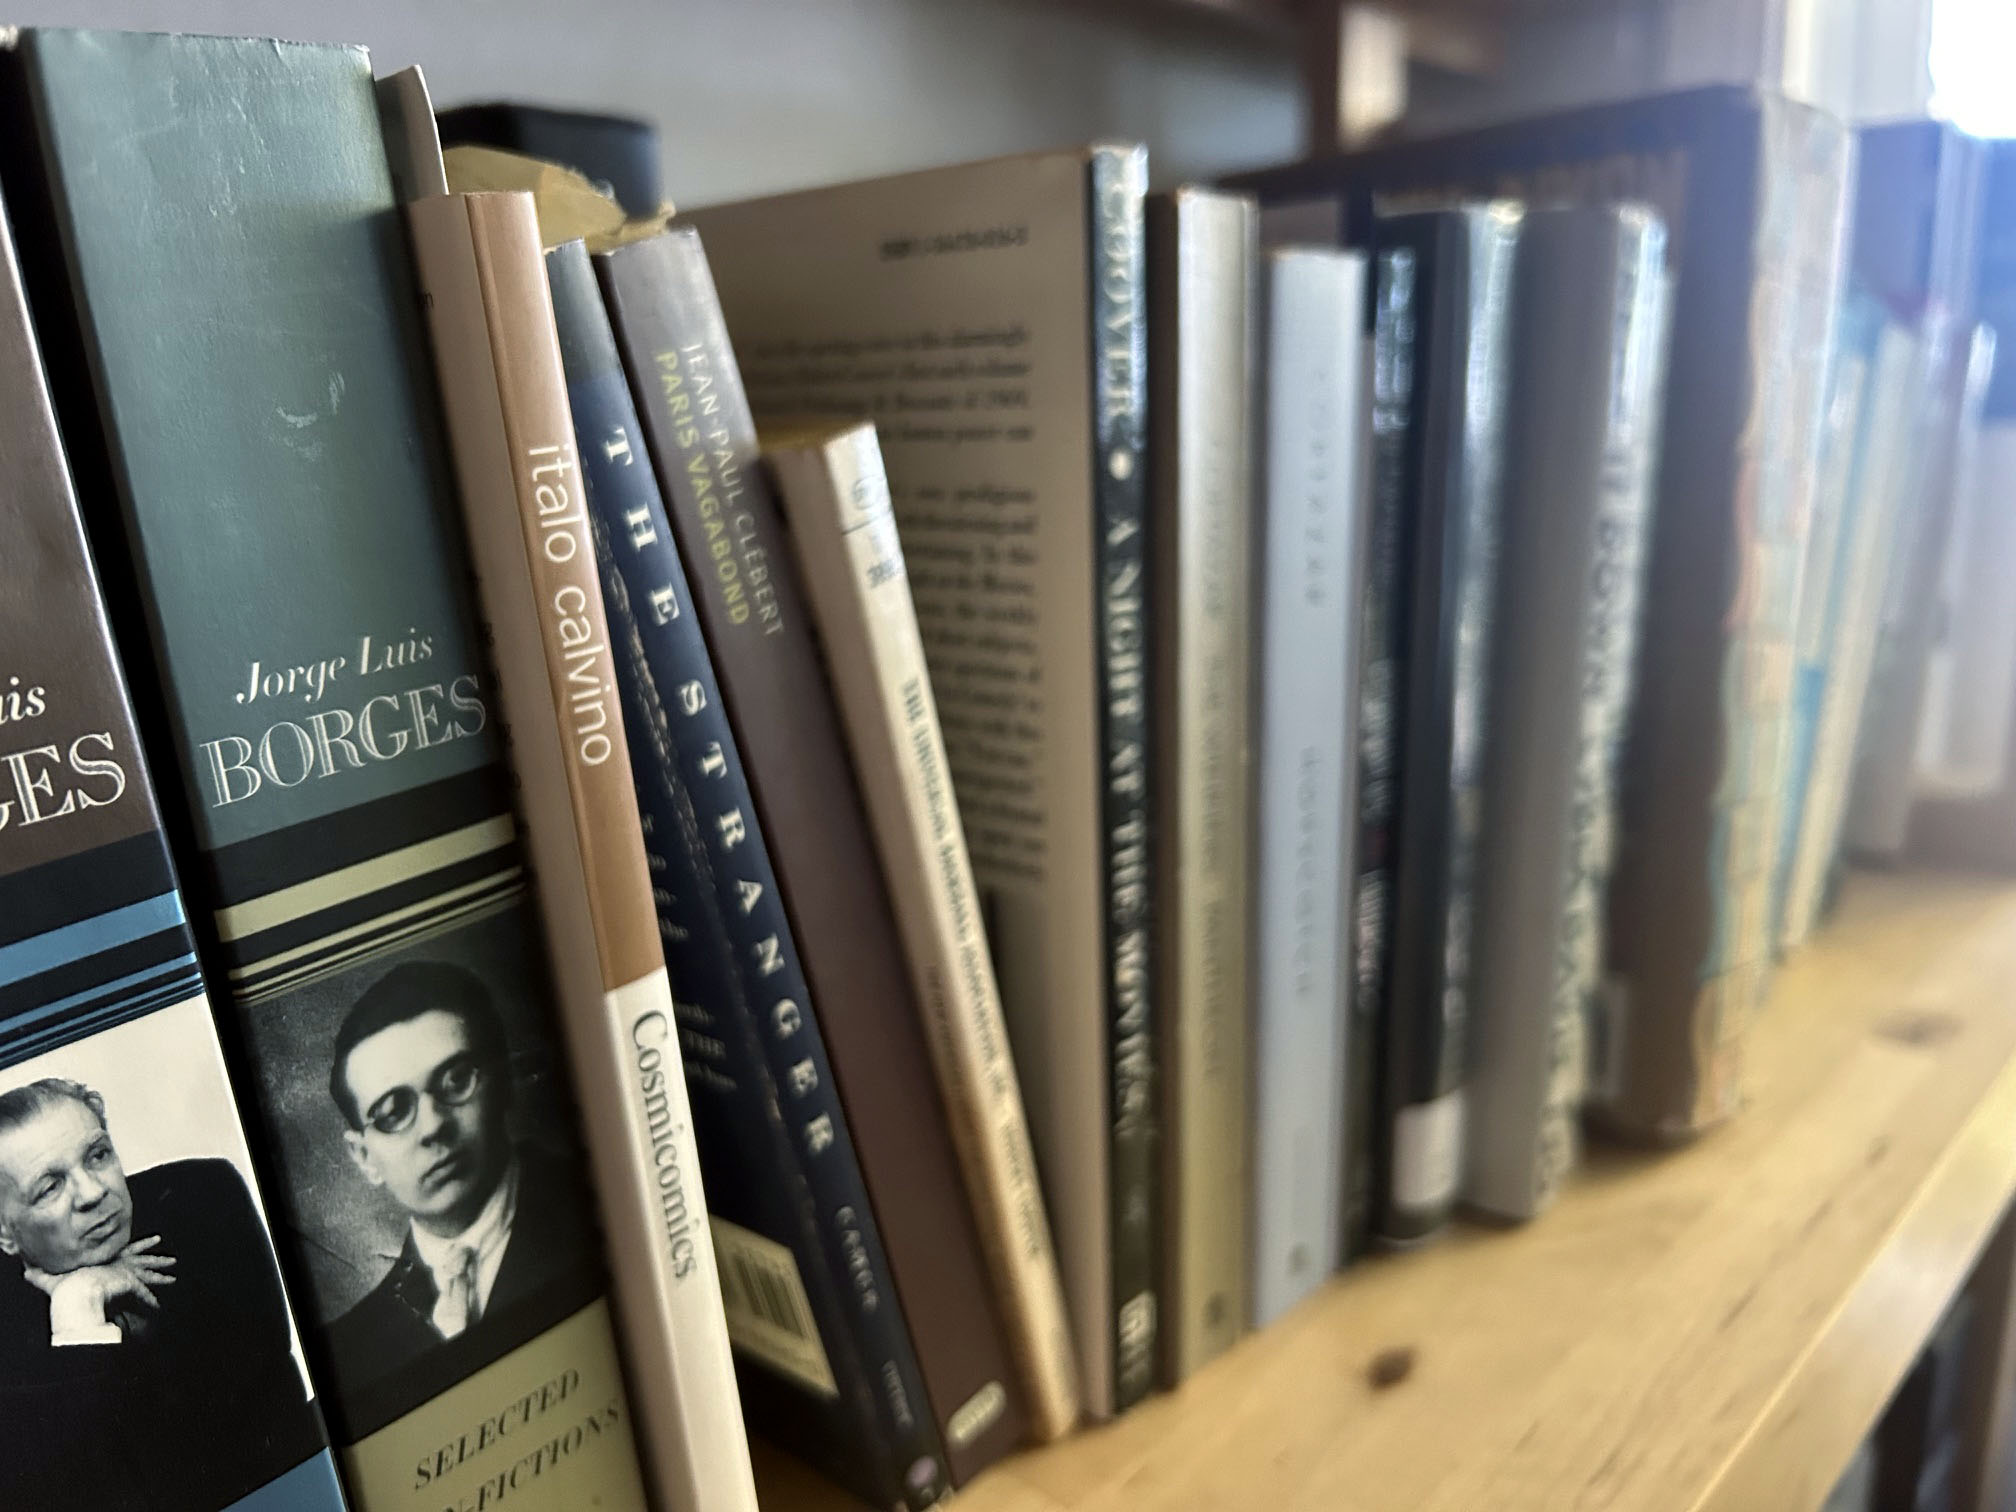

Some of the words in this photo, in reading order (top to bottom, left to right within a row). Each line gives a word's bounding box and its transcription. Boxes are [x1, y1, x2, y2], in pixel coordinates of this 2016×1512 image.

[655, 351, 700, 449] PARIS
[687, 452, 750, 625] VAGABOND
[682, 344, 744, 507] JEAN-PAUL
[528, 442, 583, 563] italo
[236, 653, 346, 705] Jorge
[358, 628, 433, 676] Luis
[553, 586, 612, 767] calvino
[200, 674, 488, 808] BORGES
[605, 425, 680, 627] THE
[675, 678, 837, 1155] STRANGER
[632, 1009, 701, 1279] Cosmicomics
[414, 1367, 579, 1491] SELECTED
[444, 1400, 620, 1512] -FICTIONS
